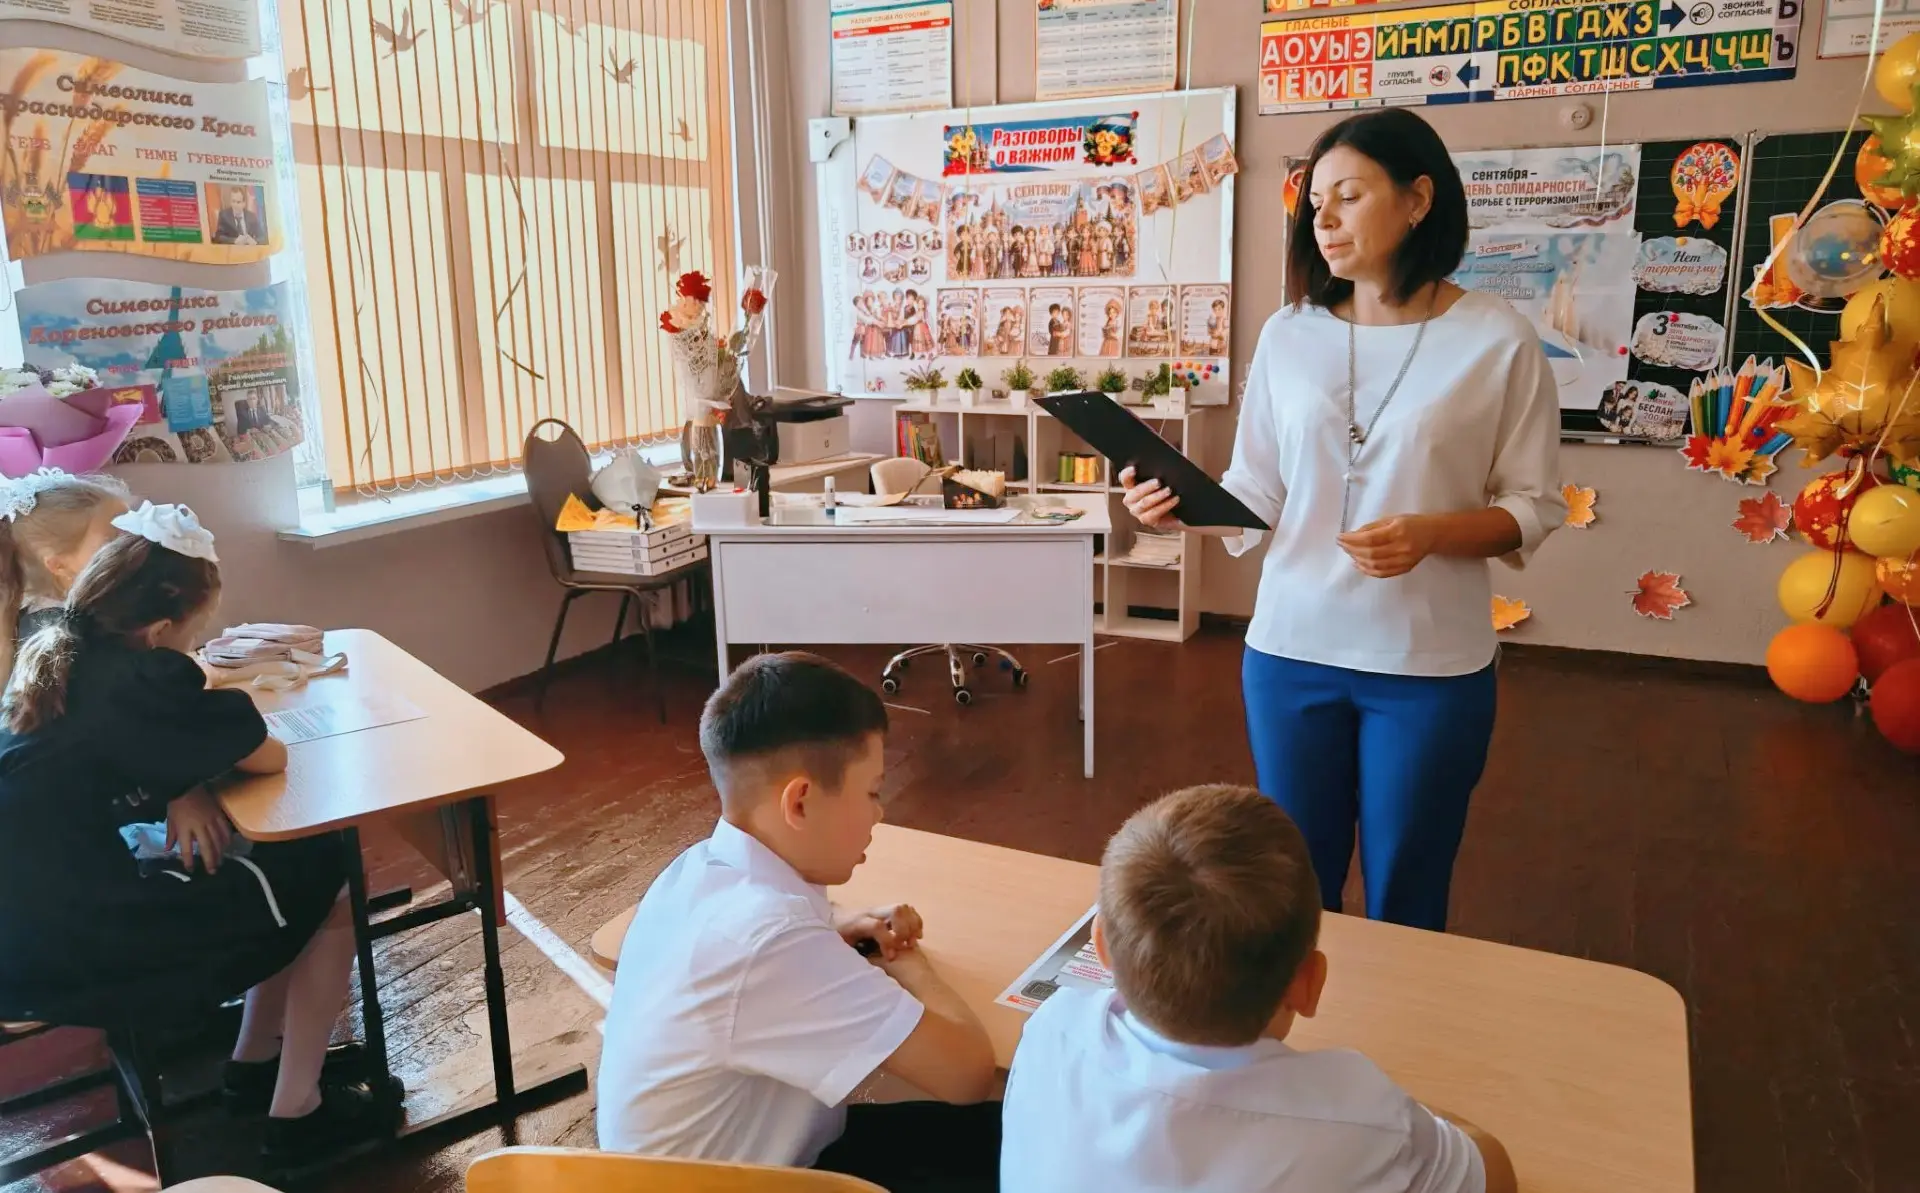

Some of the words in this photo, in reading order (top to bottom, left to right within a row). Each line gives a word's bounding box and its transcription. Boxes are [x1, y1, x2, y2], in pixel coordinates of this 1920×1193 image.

[1718, 7, 1772, 19] СОГЛАСНЫЕ
[1722, 0, 1765, 10] ЗВОНКИЕ
[1285, 16, 1350, 32] ГЛАСНЫЕ
[1378, 77, 1423, 87] СОГЛАСНЫЕ
[1507, 86, 1558, 98] ПАРНЫЕ
[1564, 79, 1641, 94] СОГЛАСНЫЕ
[200, 115, 257, 138] Края
[993, 127, 1083, 147] Разговоры
[135, 147, 178, 162] ГИМН
[187, 152, 273, 169] ГУБЕРНАТОР
[1008, 146, 1076, 165] важном
[1471, 168, 1529, 182] сентября
[1014, 184, 1072, 198] СЕНТЯБРЯ!
[1464, 184, 1492, 198] ДЕНЬ
[1495, 179, 1587, 196] СОЛИДАРНОСТИ
[1471, 197, 1504, 207] БОРЬБЕ
[1506, 197, 1512, 206] С
[1514, 194, 1580, 207] ТЕРРОРИЗМОМ
[1673, 250, 1701, 263] Нет
[86, 294, 220, 316] Символика
[28, 319, 196, 344] Кореновского
[200, 311, 278, 334] района
[1653, 314, 1669, 336] 3
[1638, 402, 1674, 416] БЕСЛАН
